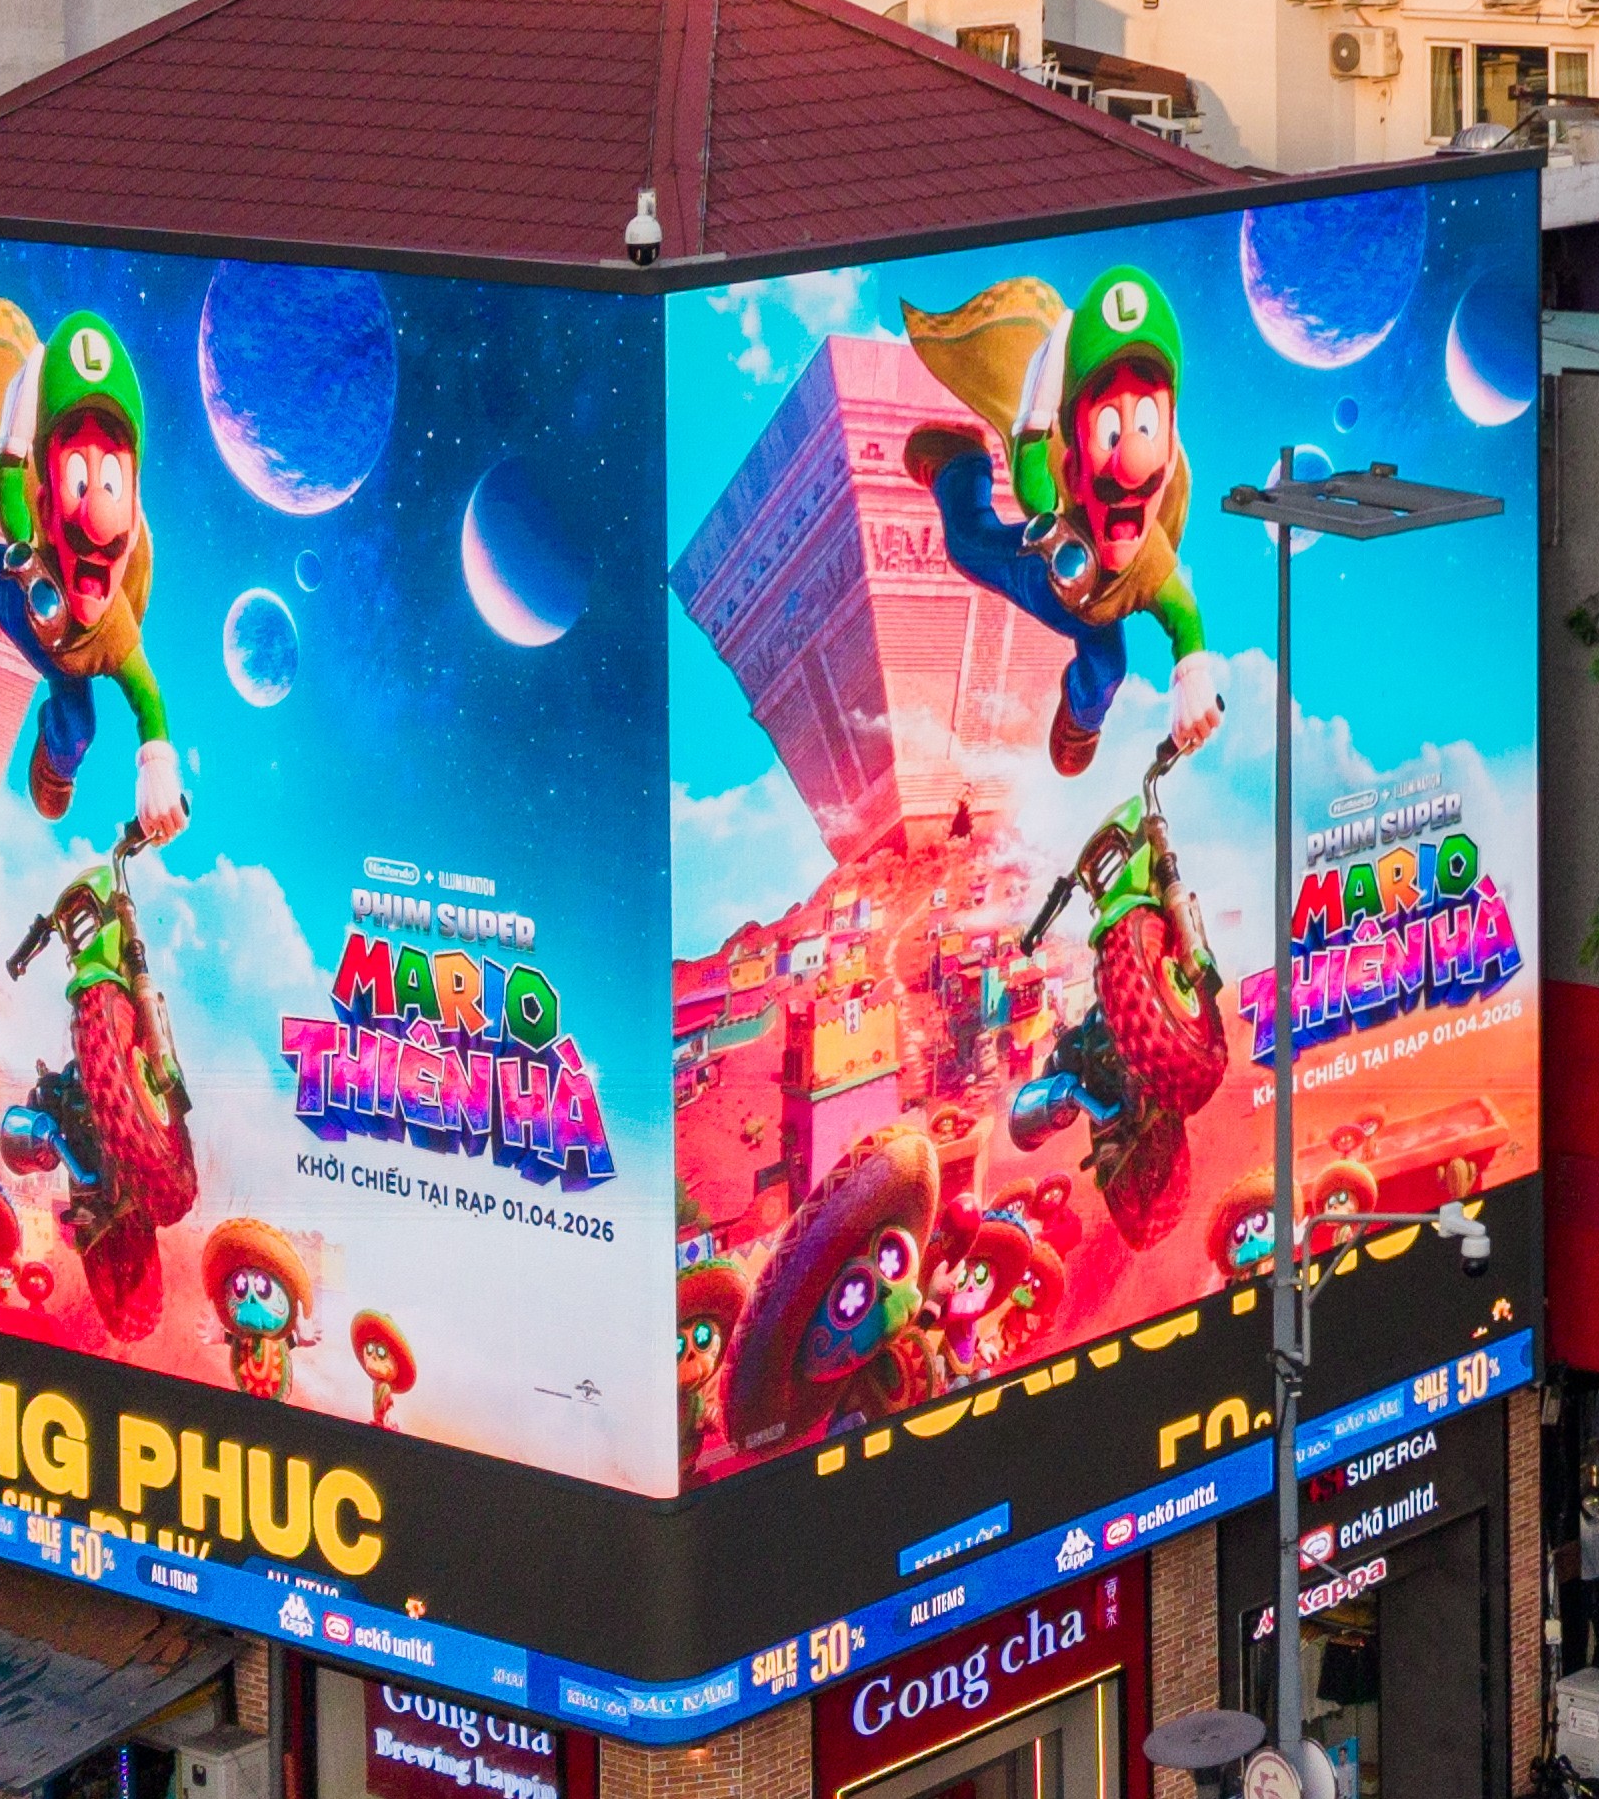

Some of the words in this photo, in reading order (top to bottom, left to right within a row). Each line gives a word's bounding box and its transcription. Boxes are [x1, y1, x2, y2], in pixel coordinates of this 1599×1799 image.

[1306, 817, 1377, 866] PHIM
[1380, 793, 1463, 842] SUPER
[352, 888, 432, 934] PHIM
[436, 903, 537, 953] SUPER
[438, 870, 497, 899] ILLUMINATION
[1291, 833, 1480, 941] MARIO
[331, 930, 562, 1053] MARIO
[1239, 917, 1427, 1063] THIÊN
[1428, 874, 1524, 998] HÀ
[1253, 1079, 1298, 1107] KHI
[1303, 1052, 1358, 1091] CHIẾU
[1361, 1044, 1390, 1071] TẠI
[1393, 1031, 1431, 1063] RẠP
[1433, 999, 1524, 1045] 01.04.2026
[280, 1014, 494, 1146] THIÊN
[496, 1034, 619, 1186] HÀ
[296, 1152, 346, 1185] KHỞI
[350, 1164, 412, 1199] CHIẾU
[417, 1178, 450, 1211] TẠI
[455, 1187, 498, 1219] RẠP
[502, 1197, 616, 1243] 01.04.2026
[1413, 1367, 1450, 1405] SALE
[118, 1412, 383, 1578] PHUC
[1346, 1431, 1438, 1487] SUPERGA
[27, 1517, 61, 1546] SALE
[151, 1562, 168, 1587] ALL
[169, 1568, 198, 1596] ITEMS
[1057, 1546, 1094, 1574] Kappa
[1298, 1557, 1387, 1619] kappa
[280, 1615, 315, 1638] Kappa
[751, 1639, 798, 1688] SALE
[910, 1599, 931, 1628] ALL
[931, 1584, 967, 1617] ITEMS
[852, 1642, 990, 1738] Gong
[1000, 1605, 1087, 1676] cha
[374, 1726, 471, 1786] Brewing
